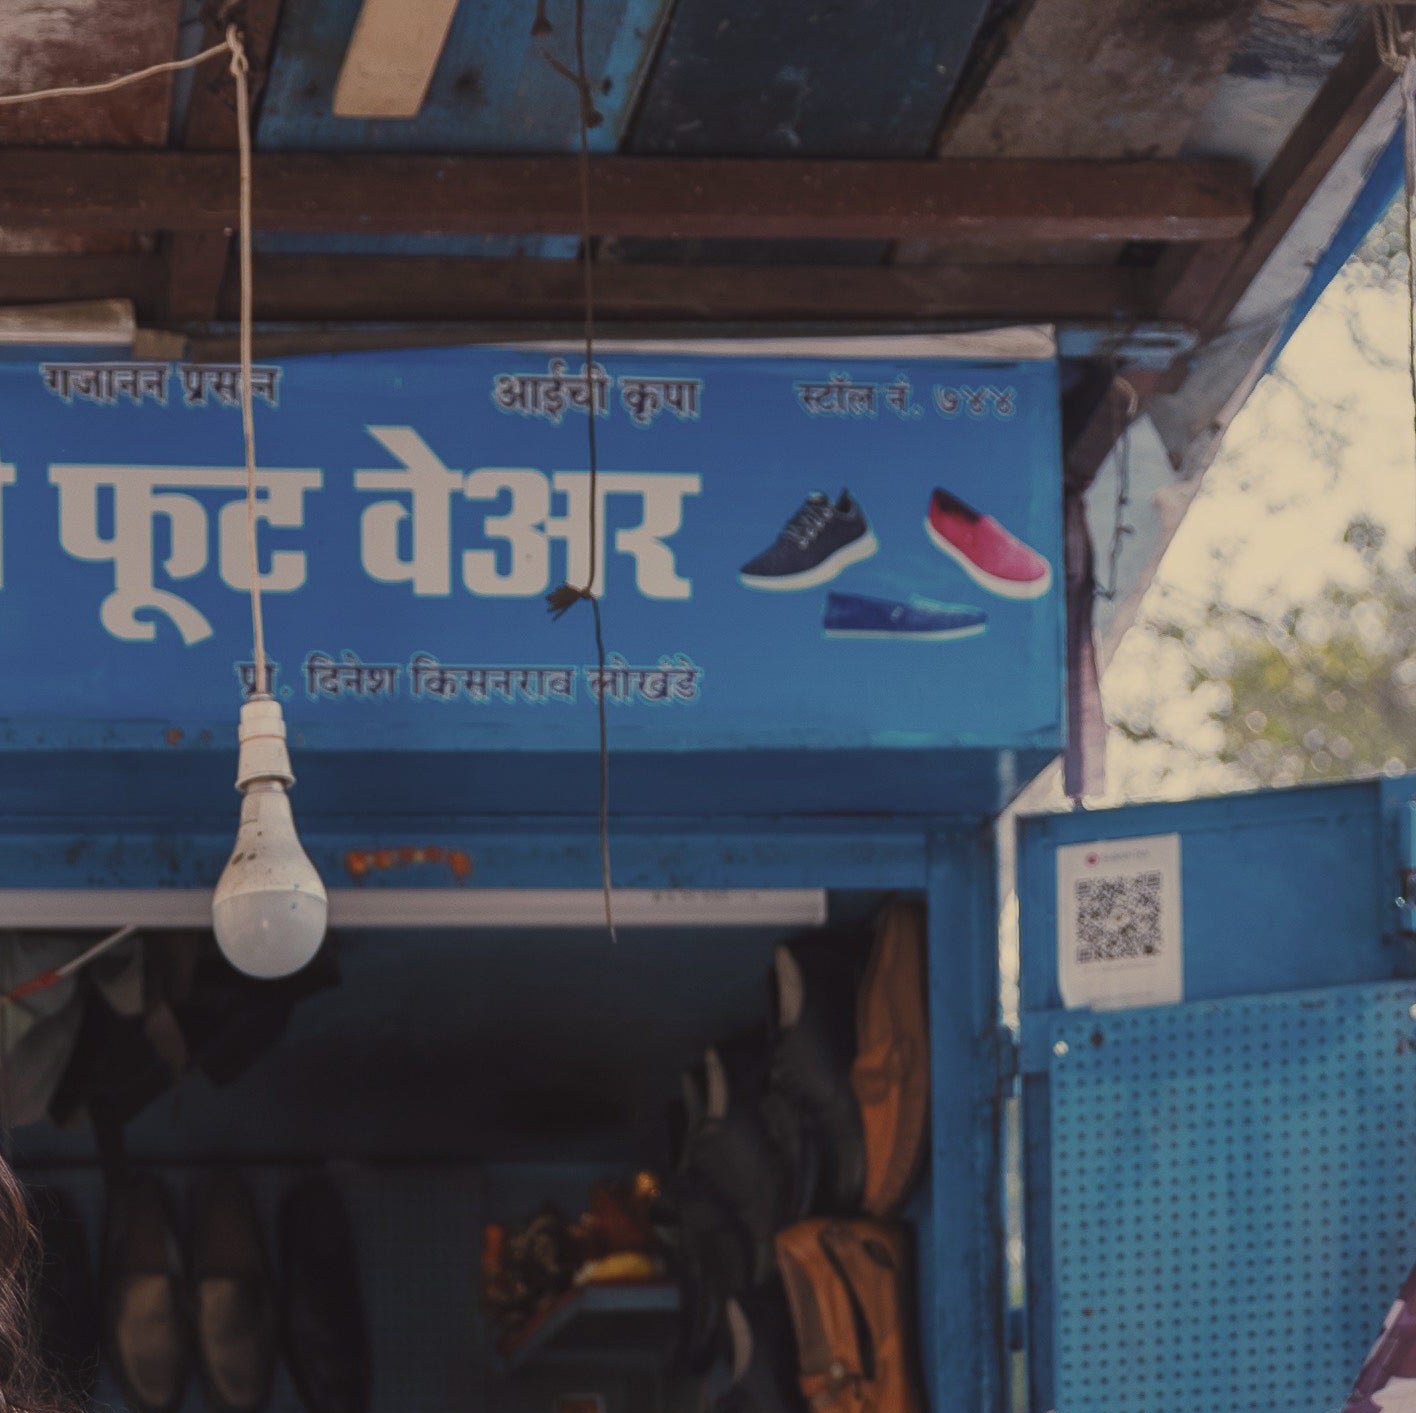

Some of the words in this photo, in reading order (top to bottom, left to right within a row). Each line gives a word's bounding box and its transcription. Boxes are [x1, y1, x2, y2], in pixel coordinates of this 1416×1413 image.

[39, 363, 169, 407] गजानन
[618, 376, 702, 428] कृपा
[49, 463, 323, 645] फूट
[354, 425, 702, 599] वेअर
[302, 650, 399, 699] दिनेश
[407, 651, 577, 703] किसनराव
